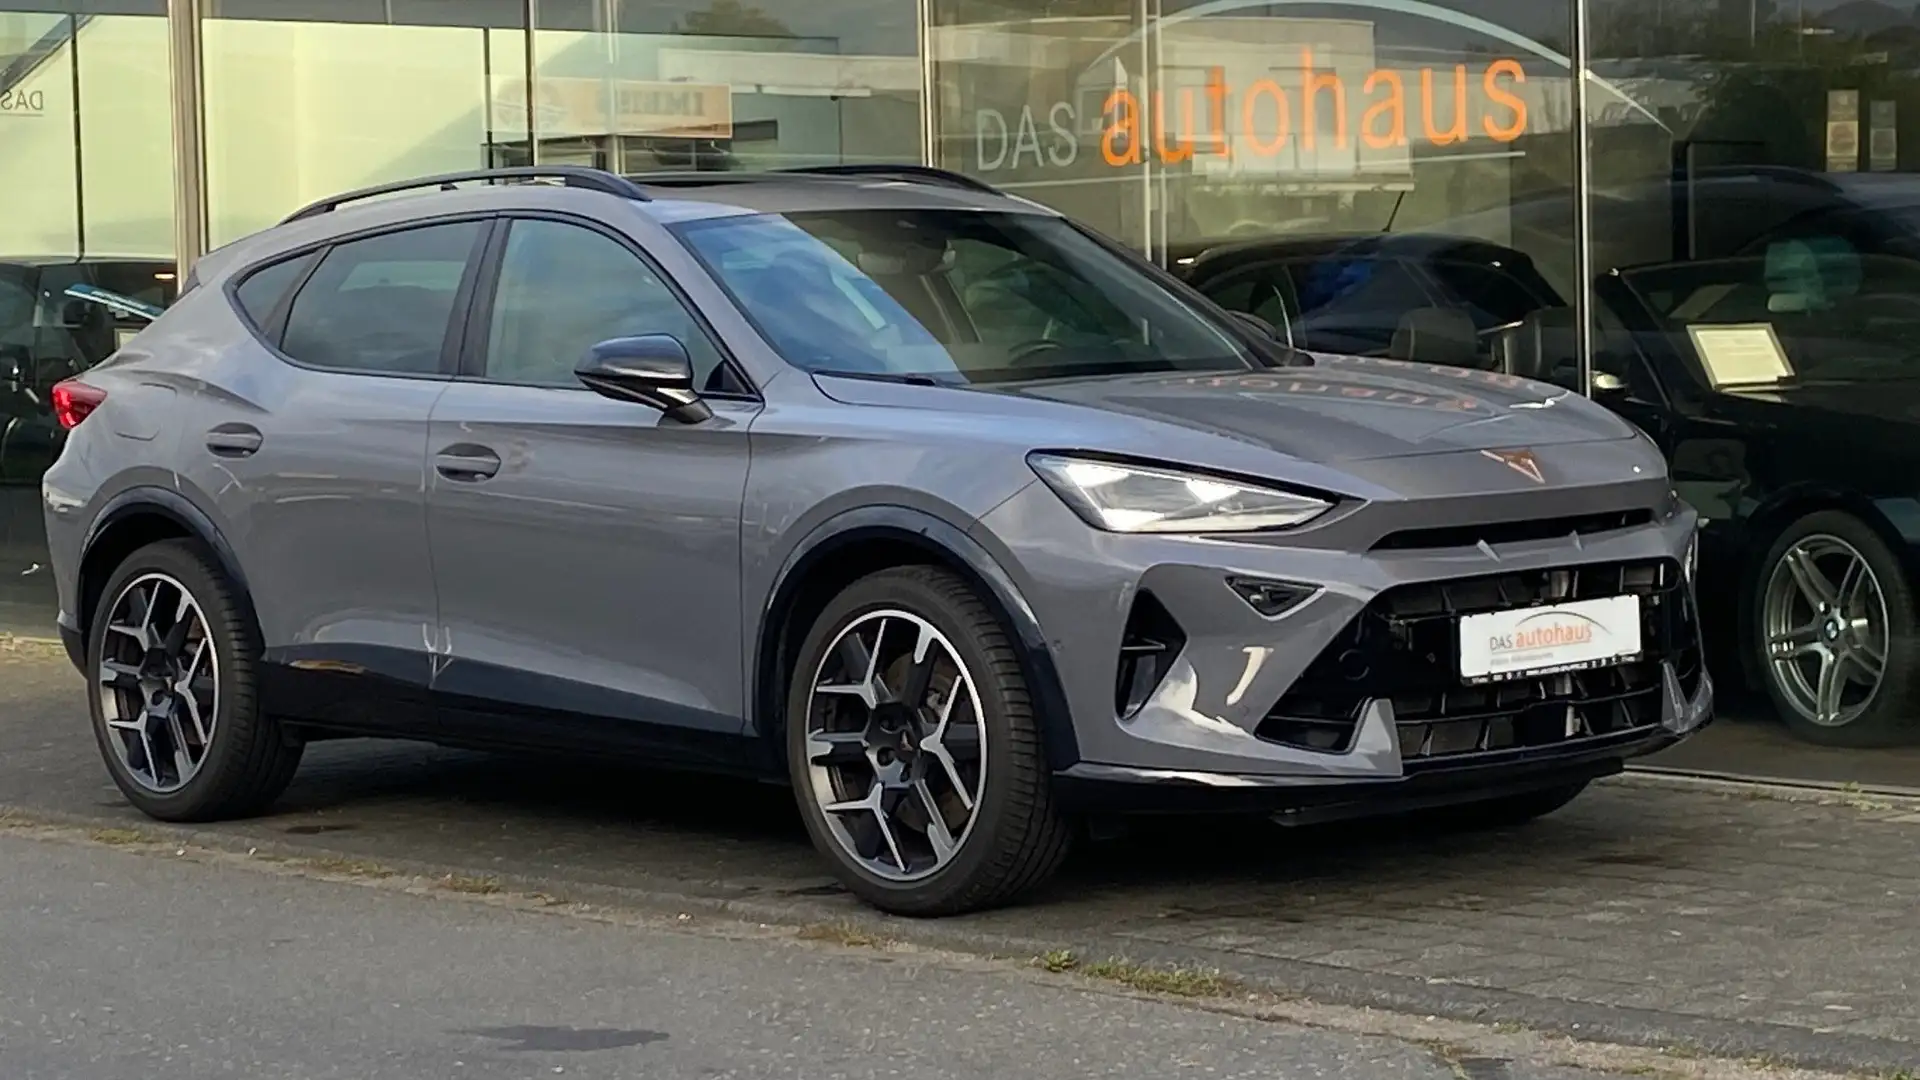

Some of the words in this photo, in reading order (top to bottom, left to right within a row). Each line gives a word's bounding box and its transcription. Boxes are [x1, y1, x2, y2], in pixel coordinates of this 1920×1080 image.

[976, 100, 1078, 171] DAS
[1101, 46, 1528, 167] autohaus
[1489, 634, 1513, 651] DAS
[1516, 622, 1593, 648] autohaus
